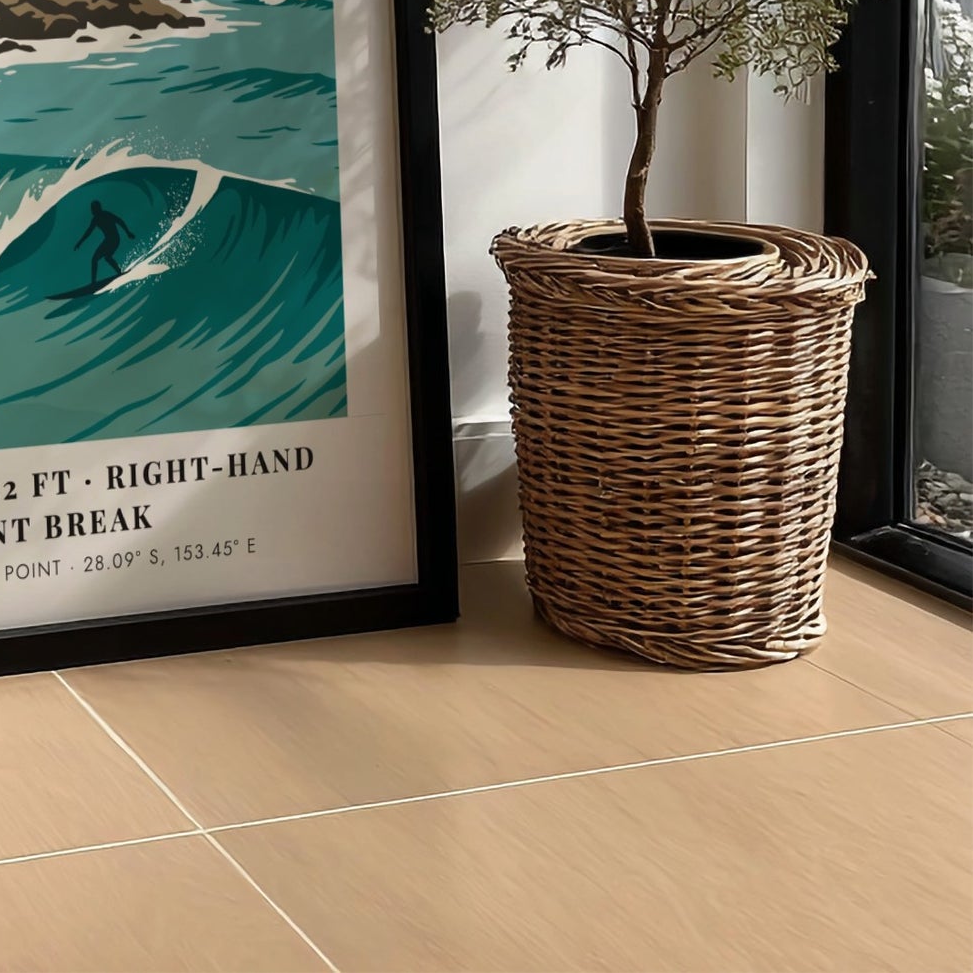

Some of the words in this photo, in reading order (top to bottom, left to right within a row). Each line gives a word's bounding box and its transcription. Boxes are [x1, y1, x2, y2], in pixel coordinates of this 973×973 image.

[31, 469, 71, 498] FT
[106, 445, 315, 490] RIGHT-HAND
[44, 504, 153, 540] BREAK
[5, 559, 61, 581] POINT
[83, 550, 141, 573] 28.09°
[149, 548, 165, 567] S,
[174, 539, 239, 562] 153.45°
[247, 537, 256, 554] E
